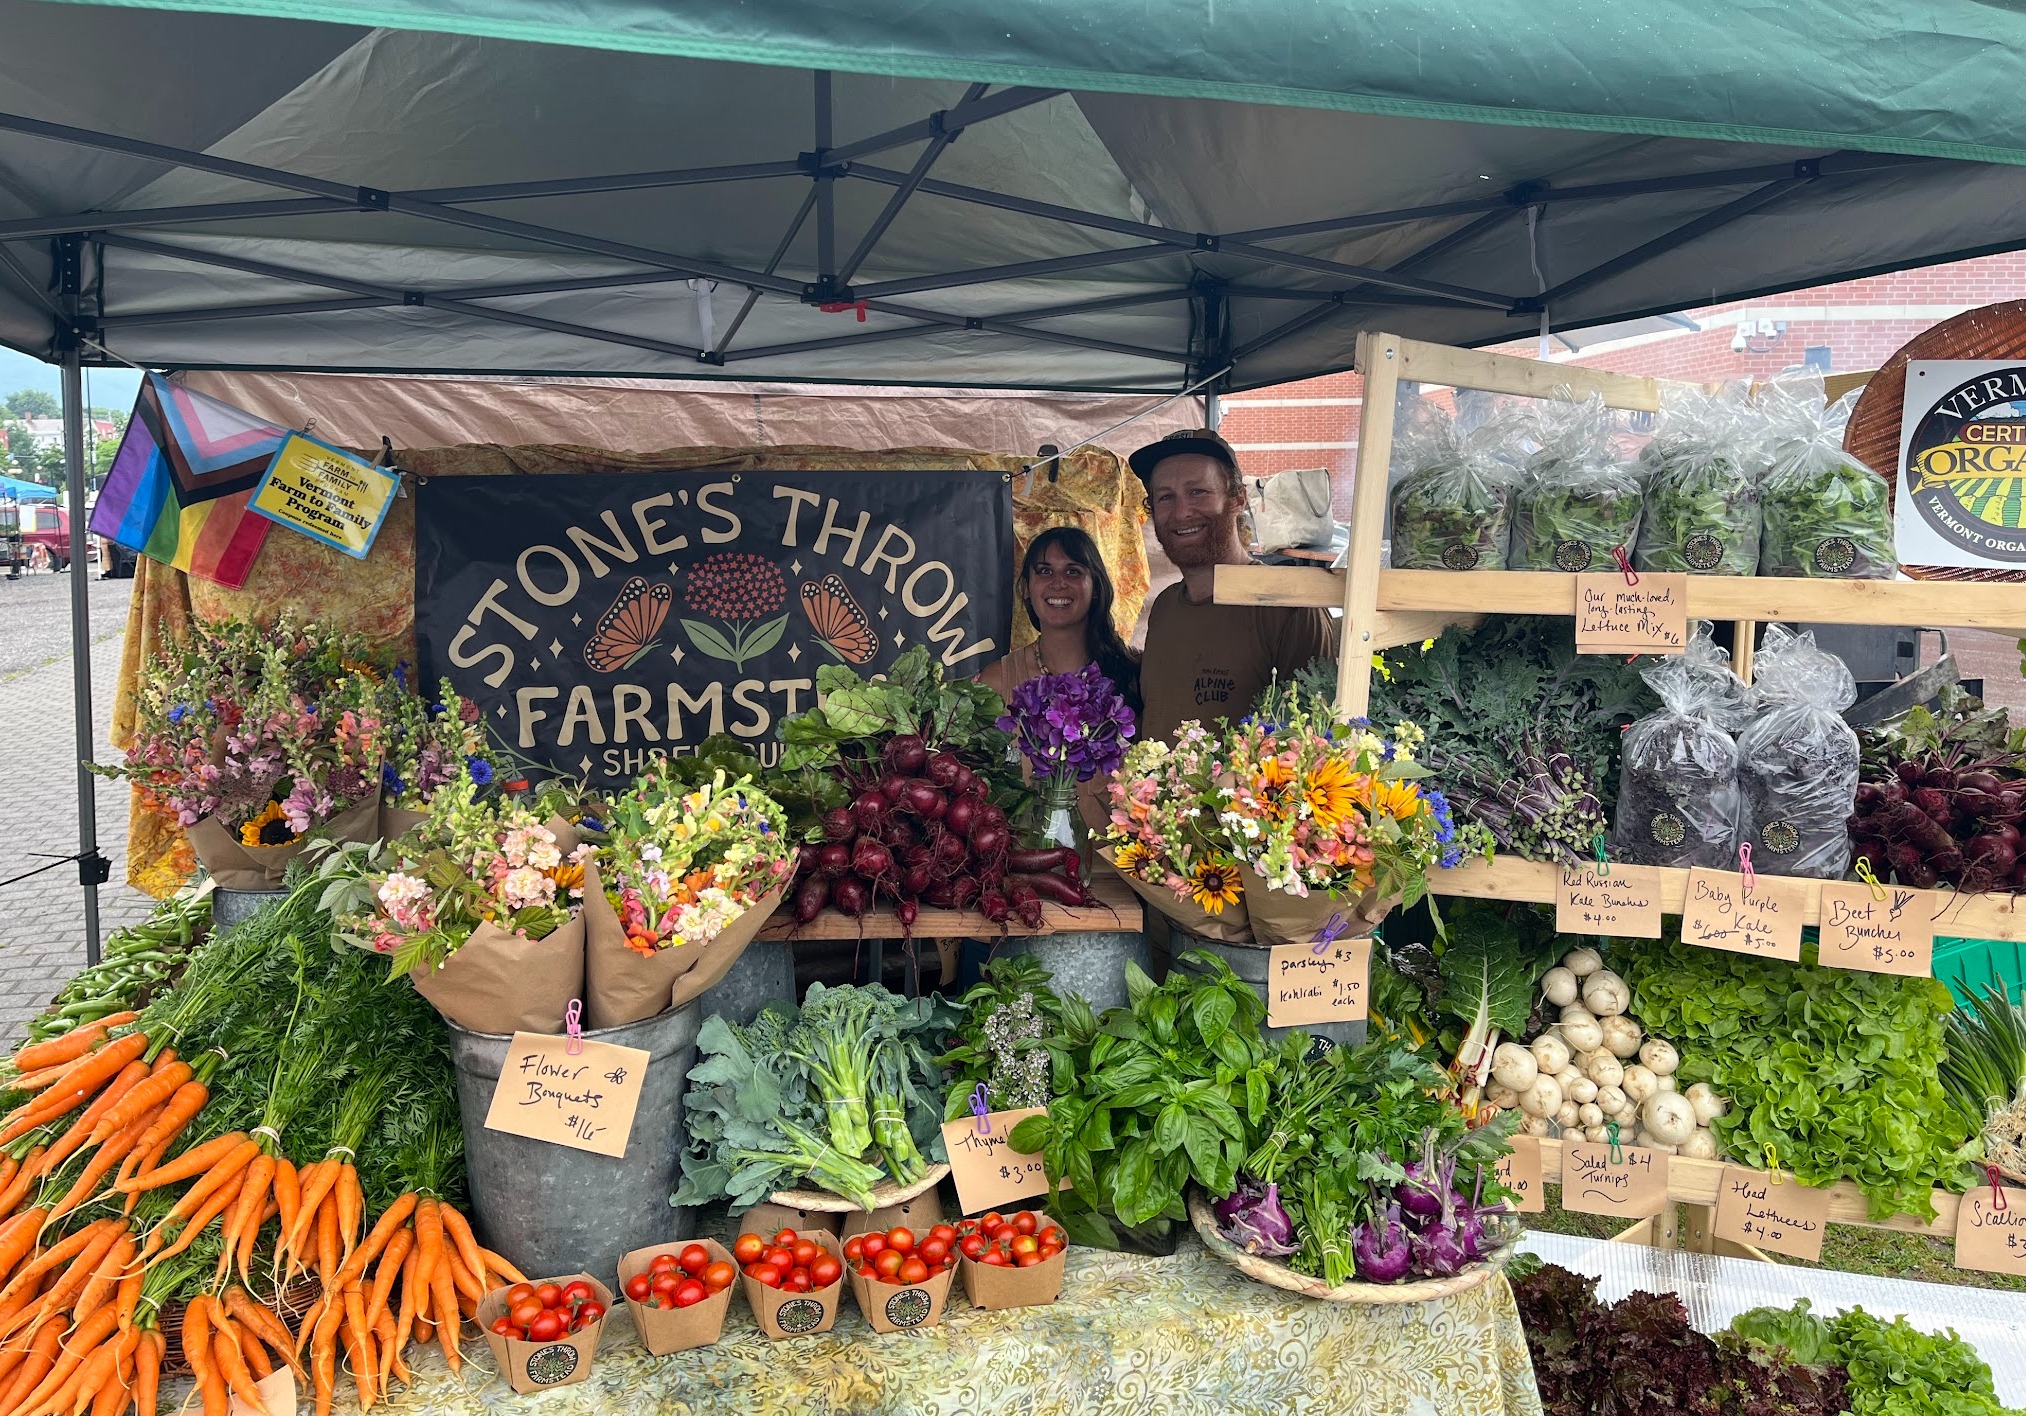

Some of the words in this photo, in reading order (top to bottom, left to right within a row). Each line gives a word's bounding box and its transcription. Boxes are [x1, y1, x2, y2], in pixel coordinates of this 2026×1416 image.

[1966, 424, 2026, 442] CERT
[322, 461, 350, 478] FARM
[318, 472, 352, 490] FAMILY
[300, 476, 355, 509] Vermont
[269, 477, 306, 500] Farm
[310, 495, 323, 507] to
[325, 502, 372, 529] Family
[286, 497, 345, 530] Program
[1928, 496, 1984, 544] VERMONT
[278, 509, 301, 521] Coupons
[303, 520, 329, 533] redeemed
[330, 531, 342, 539] here
[1686, 552, 1718, 568] FARMSTEAD
[1817, 557, 1853, 572] FARMSTEAD
[448, 482, 742, 688] STONE'S
[772, 485, 996, 667] THROW
[1584, 588, 1605, 602] Our
[1581, 618, 1630, 632] Lettuce
[1637, 619, 1664, 638] Mix
[1195, 690, 1229, 706] CLUB
[517, 674, 887, 748] FARMST
[1563, 871, 1582, 886] Red
[1586, 870, 1633, 888] Russian
[1570, 892, 1594, 907] Kale
[1601, 893, 1649, 908] Bunches
[1694, 880, 1732, 914] Baby
[1742, 885, 1779, 913] Purple
[1734, 912, 1773, 934] Kale
[1828, 900, 1877, 927] Beet
[1839, 924, 1901, 951] Bunches
[1872, 945, 1915, 964] $5.00
[1332, 995, 1355, 1007] each
[519, 1054, 589, 1080] Flower
[519, 1081, 603, 1109] Bouquets
[1571, 1149, 1607, 1172] Salad
[1581, 1170, 1629, 1188] Turnips
[1731, 1181, 1767, 1200] Head
[1746, 1203, 1817, 1231] Lettuces
[779, 1317, 820, 1332] FARMSTEAD
[888, 1308, 928, 1326] FARMSTEAD
[530, 1364, 574, 1384] FARMSTEAD
